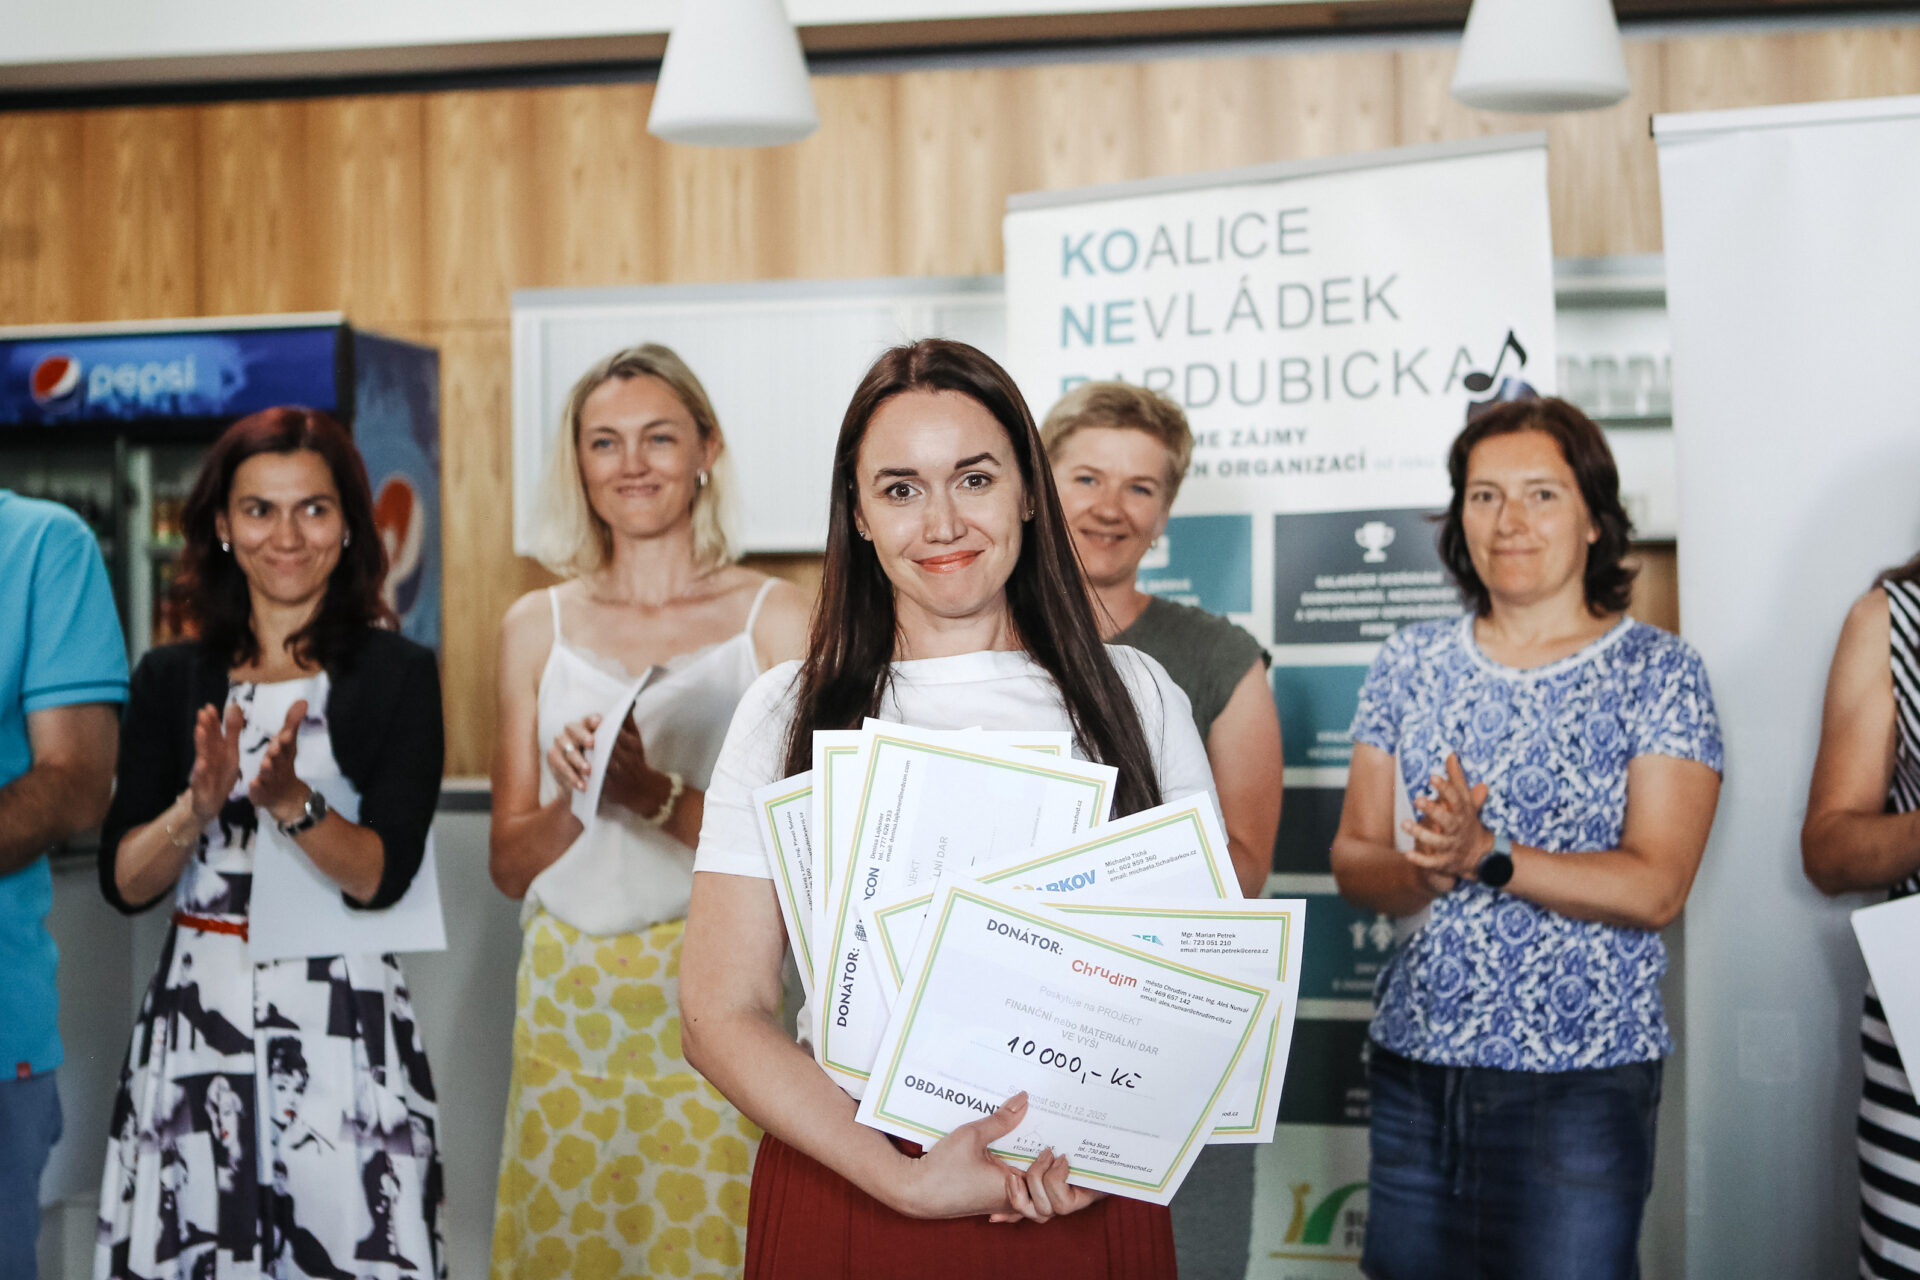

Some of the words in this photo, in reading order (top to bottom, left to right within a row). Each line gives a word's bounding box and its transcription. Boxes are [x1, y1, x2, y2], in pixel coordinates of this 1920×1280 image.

[1060, 207, 1311, 278] KOALICE
[1060, 274, 1400, 348] NEVLÁDEK
[87, 352, 196, 405] pepsi
[1060, 346, 1474, 410] RDUBICKA
[1231, 427, 1307, 448] ZÁJMY
[1217, 447, 1366, 477] ORGANIZACÍ
[1105, 856, 1131, 867] Michaela
[1119, 863, 1131, 871] 602
[864, 867, 880, 900] CON
[1036, 869, 1096, 892] RKOV
[1110, 873, 1128, 882] email:
[986, 918, 1064, 955] DONÁTOR:
[1181, 931, 1193, 939] Mgr.
[836, 947, 860, 1028] DONÁTOR:
[1071, 959, 1138, 988] Chrudim
[1154, 990, 1166, 998] 469
[1166, 993, 1178, 1002] 657
[1179, 998, 1191, 1006] 142
[1163, 984, 1187, 996] Chrudim
[1039, 985, 1082, 1010] Poskytuje
[1083, 1002, 1096, 1012] na
[1097, 1005, 1143, 1027] PROJEKT
[1004, 997, 1053, 1022] FINANČNÍ
[1054, 1013, 1078, 1030] nebo
[1079, 1023, 1138, 1049] MATERIÁLNÍ
[1139, 1042, 1159, 1056] DAR
[1061, 1029, 1075, 1041] VE
[1110, 1068, 1142, 1088] Kč
[904, 1075, 1000, 1115] OBDAROVAN
[1049, 1099, 1060, 1109] do
